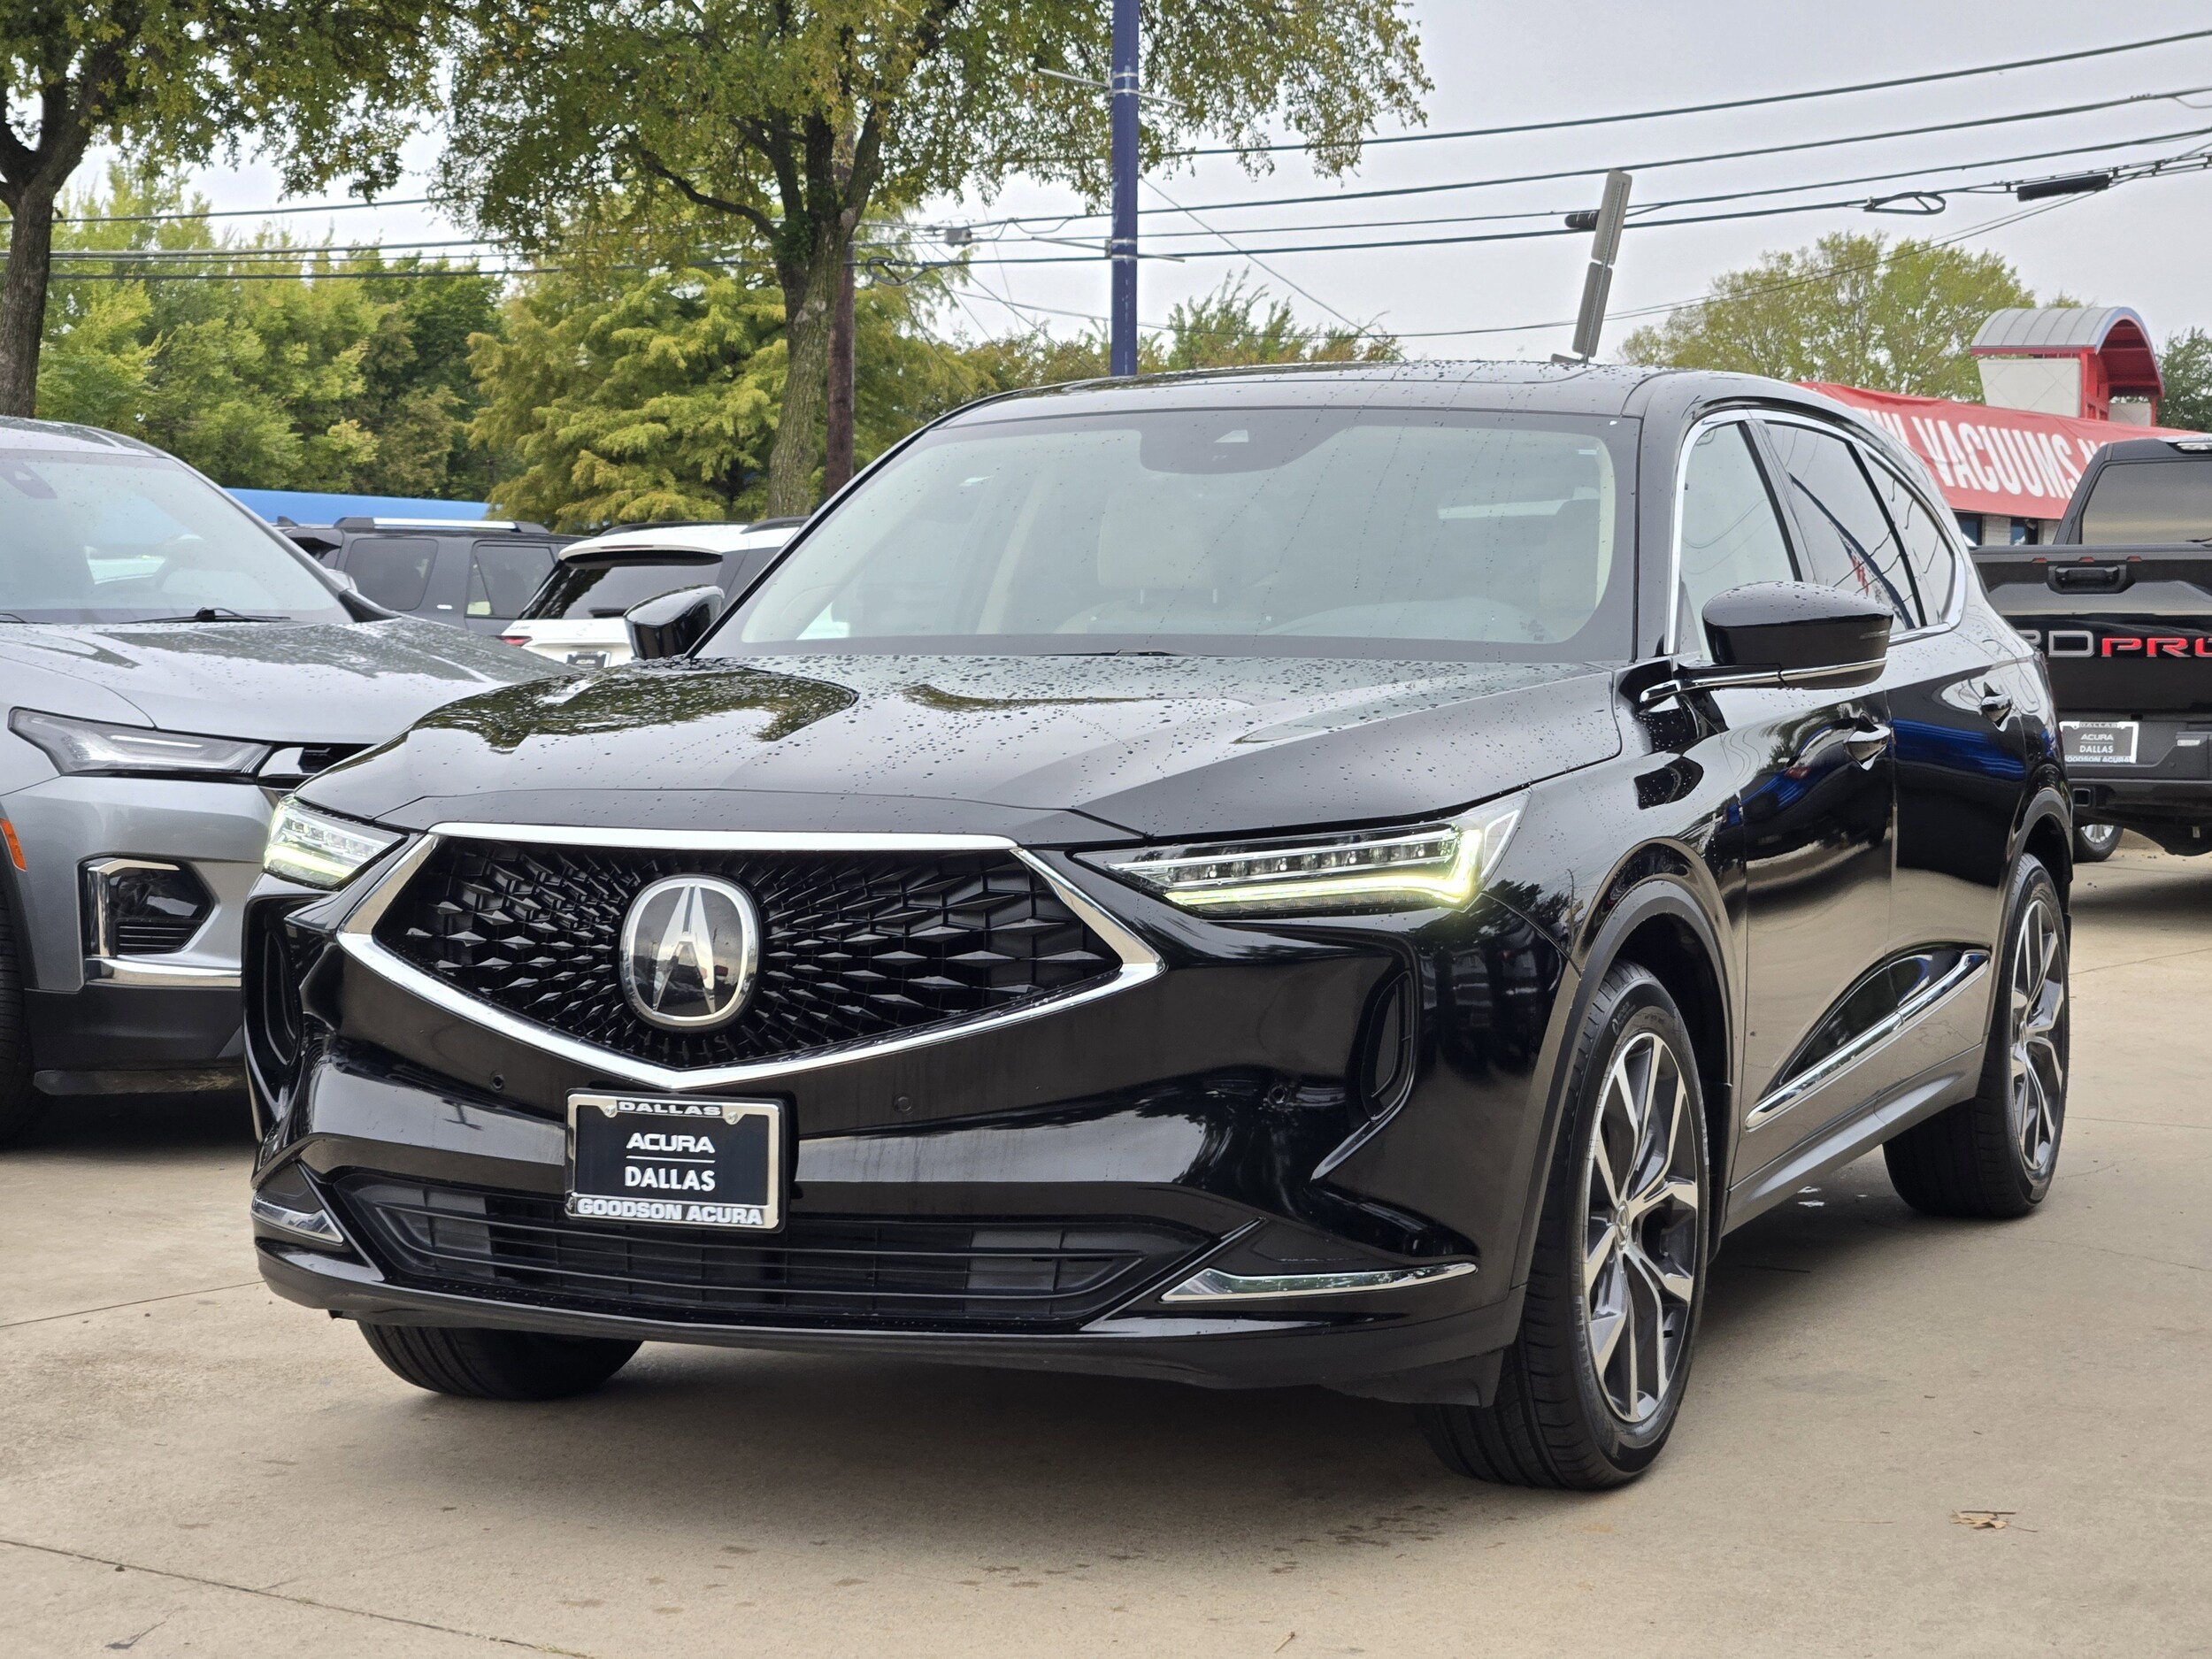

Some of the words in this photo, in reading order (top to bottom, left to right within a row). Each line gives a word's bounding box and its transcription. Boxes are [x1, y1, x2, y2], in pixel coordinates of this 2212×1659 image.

[618, 1102, 722, 1116] DALLAS
[626, 1132, 716, 1154] ACURA
[624, 1165, 716, 1192] DALLAS
[577, 1198, 682, 1220] GOODSON
[685, 1205, 764, 1225] ACURA
